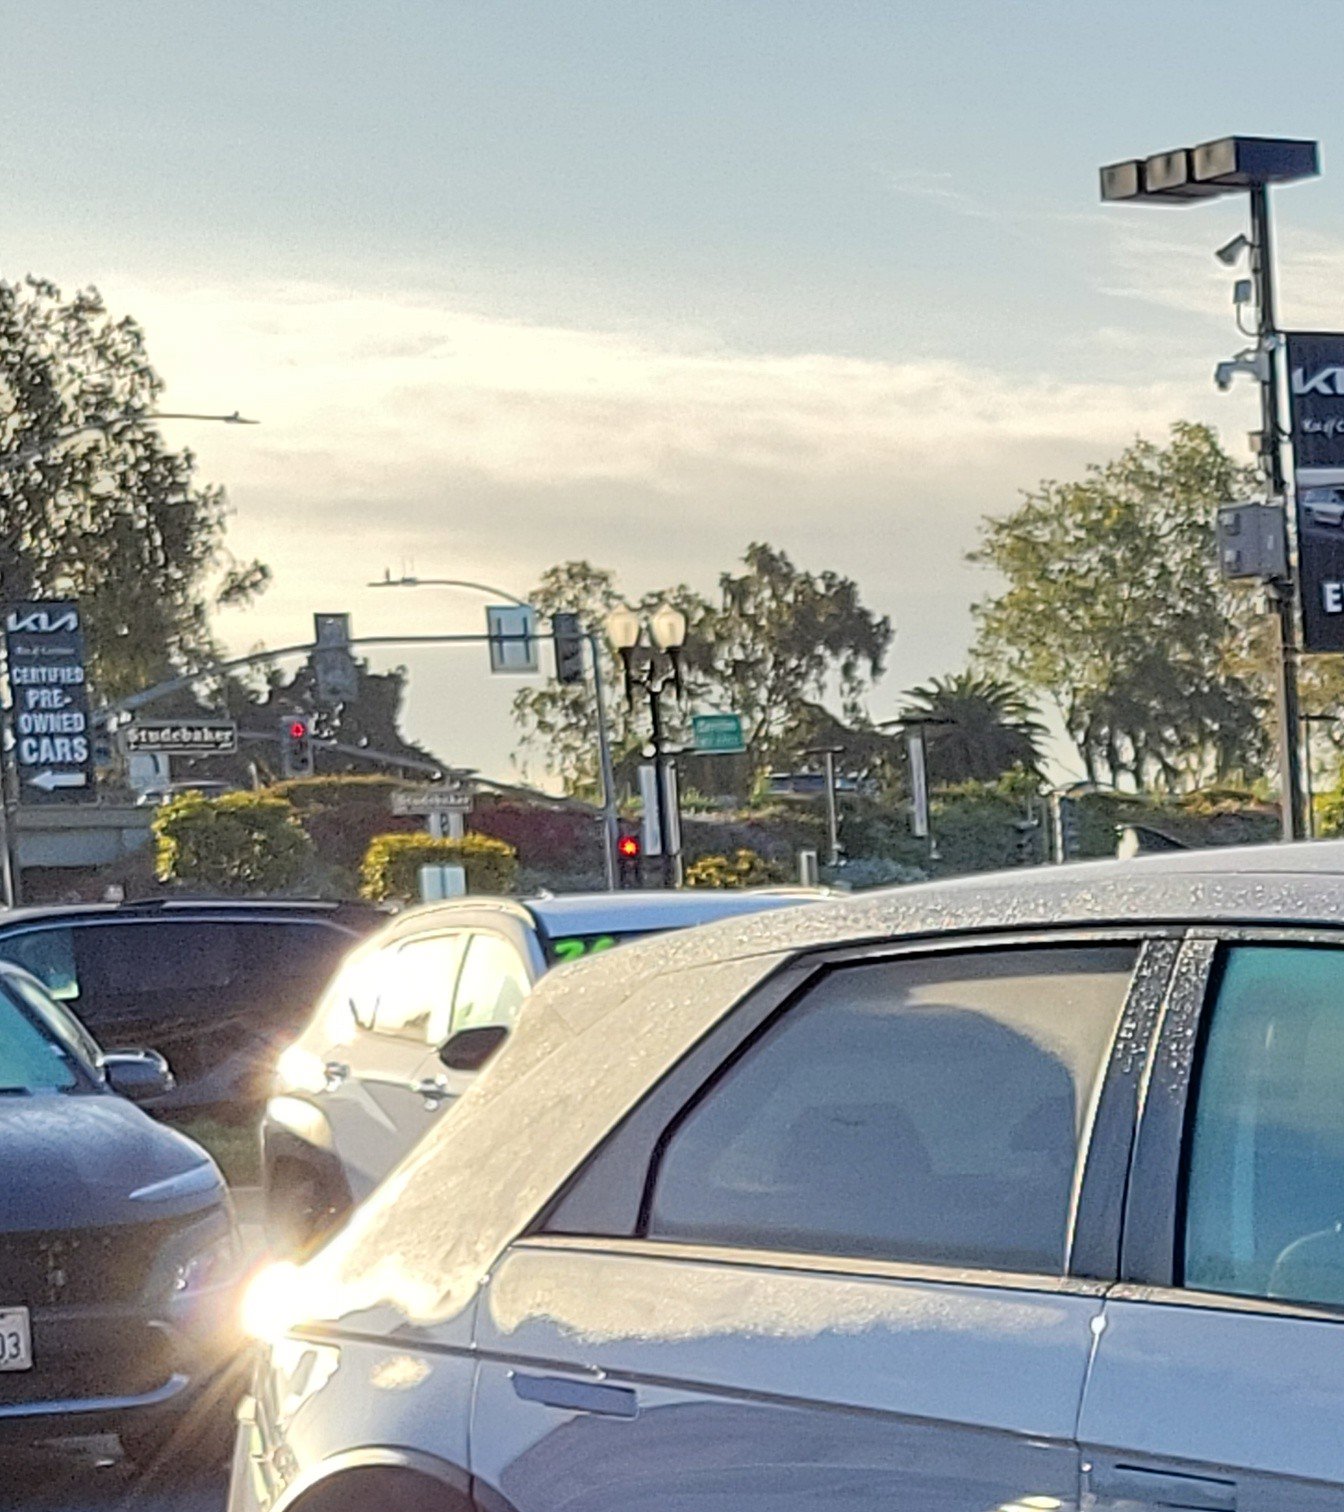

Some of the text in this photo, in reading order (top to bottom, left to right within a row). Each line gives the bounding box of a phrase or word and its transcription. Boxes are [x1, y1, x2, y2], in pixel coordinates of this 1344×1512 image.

[7, 612, 78, 632] KIA
[26, 687, 72, 709] PRE-
[20, 713, 85, 734] OWNED
[22, 736, 88, 764] CARS
